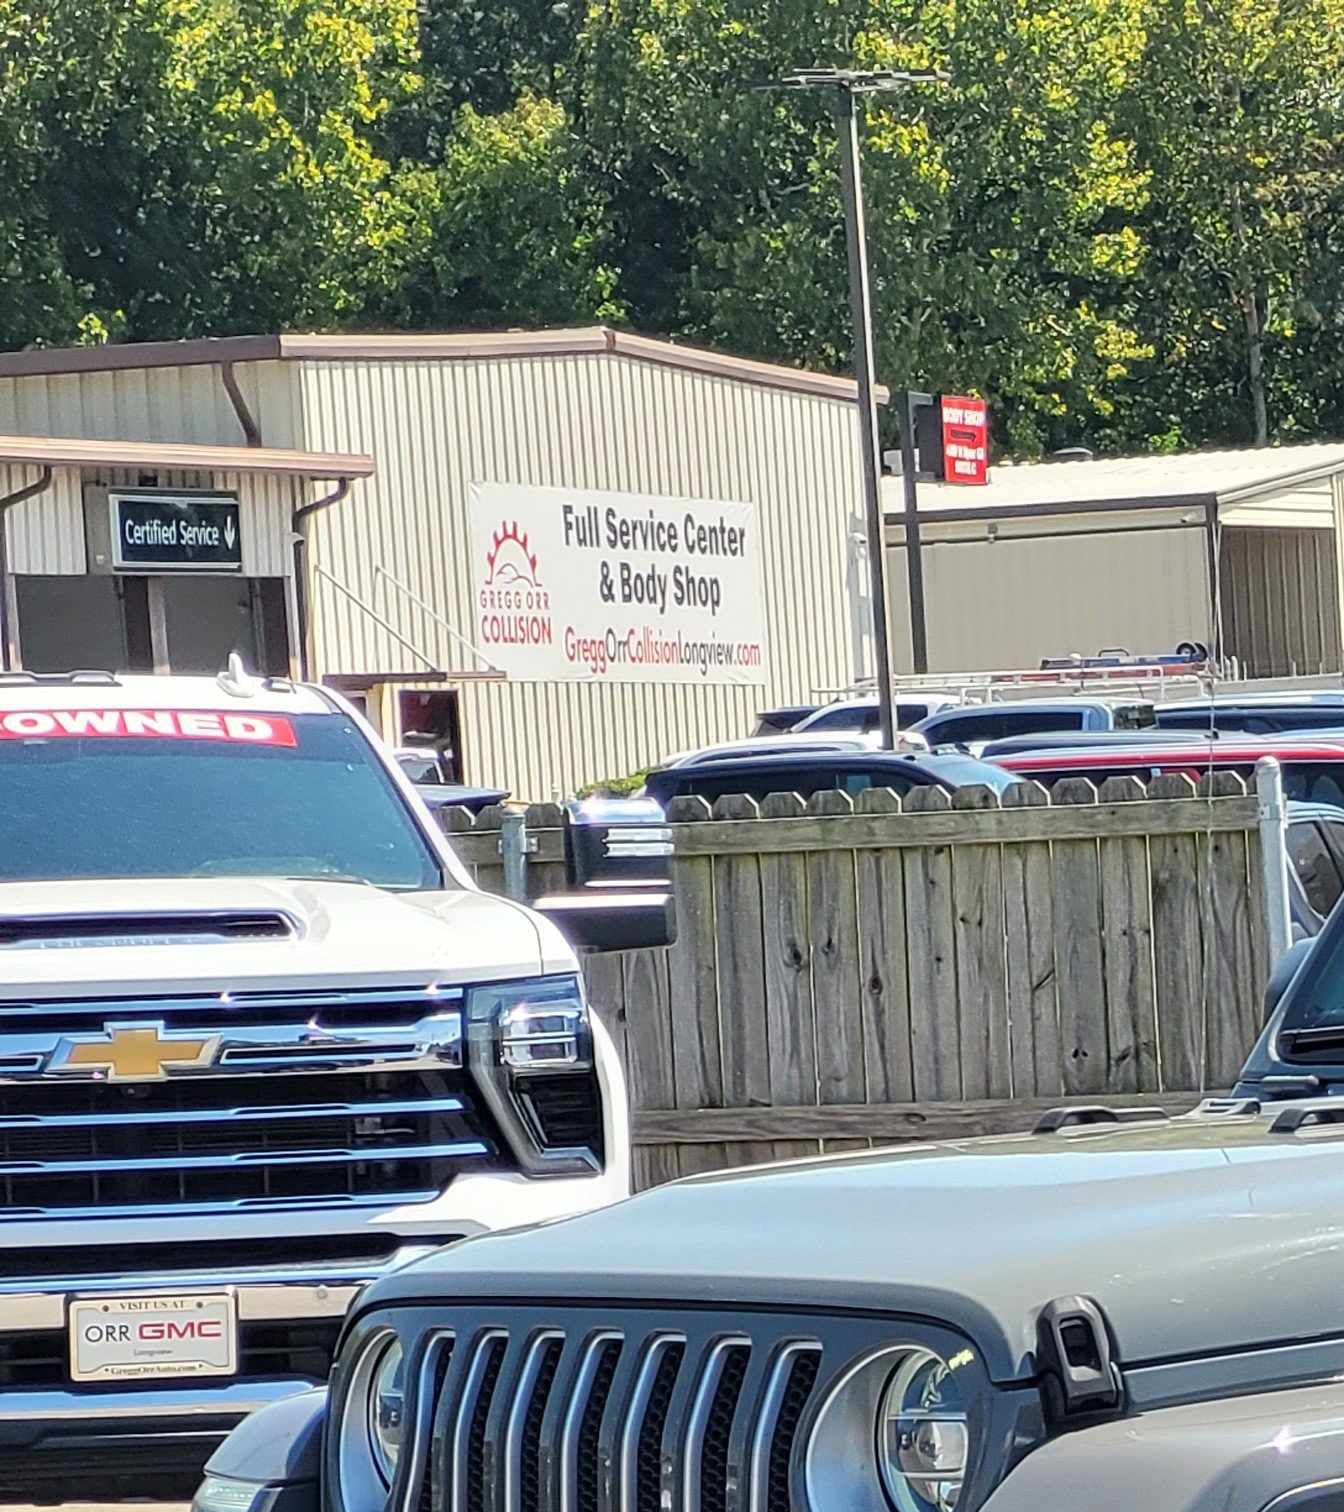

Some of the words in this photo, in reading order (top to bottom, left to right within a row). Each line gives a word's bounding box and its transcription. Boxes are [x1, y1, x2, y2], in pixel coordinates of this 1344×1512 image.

[125, 517, 177, 545] Certified
[179, 519, 219, 546] Service
[562, 504, 600, 549] Full
[605, 507, 678, 552] Service
[683, 512, 746, 557] Center
[480, 589, 522, 610] GREGG
[526, 590, 550, 610] ORR
[600, 560, 615, 603] &
[619, 561, 668, 615] Body
[673, 564, 722, 616] Shop
[481, 614, 553, 645] COLLISION
[564, 624, 762, 677] GreggOrrCollisionLongview.com
[0, 711, 273, 739] OWNED
[120, 1301, 149, 1310] VISIT
[84, 1324, 132, 1343] ORR
[137, 1320, 222, 1341] GMC
